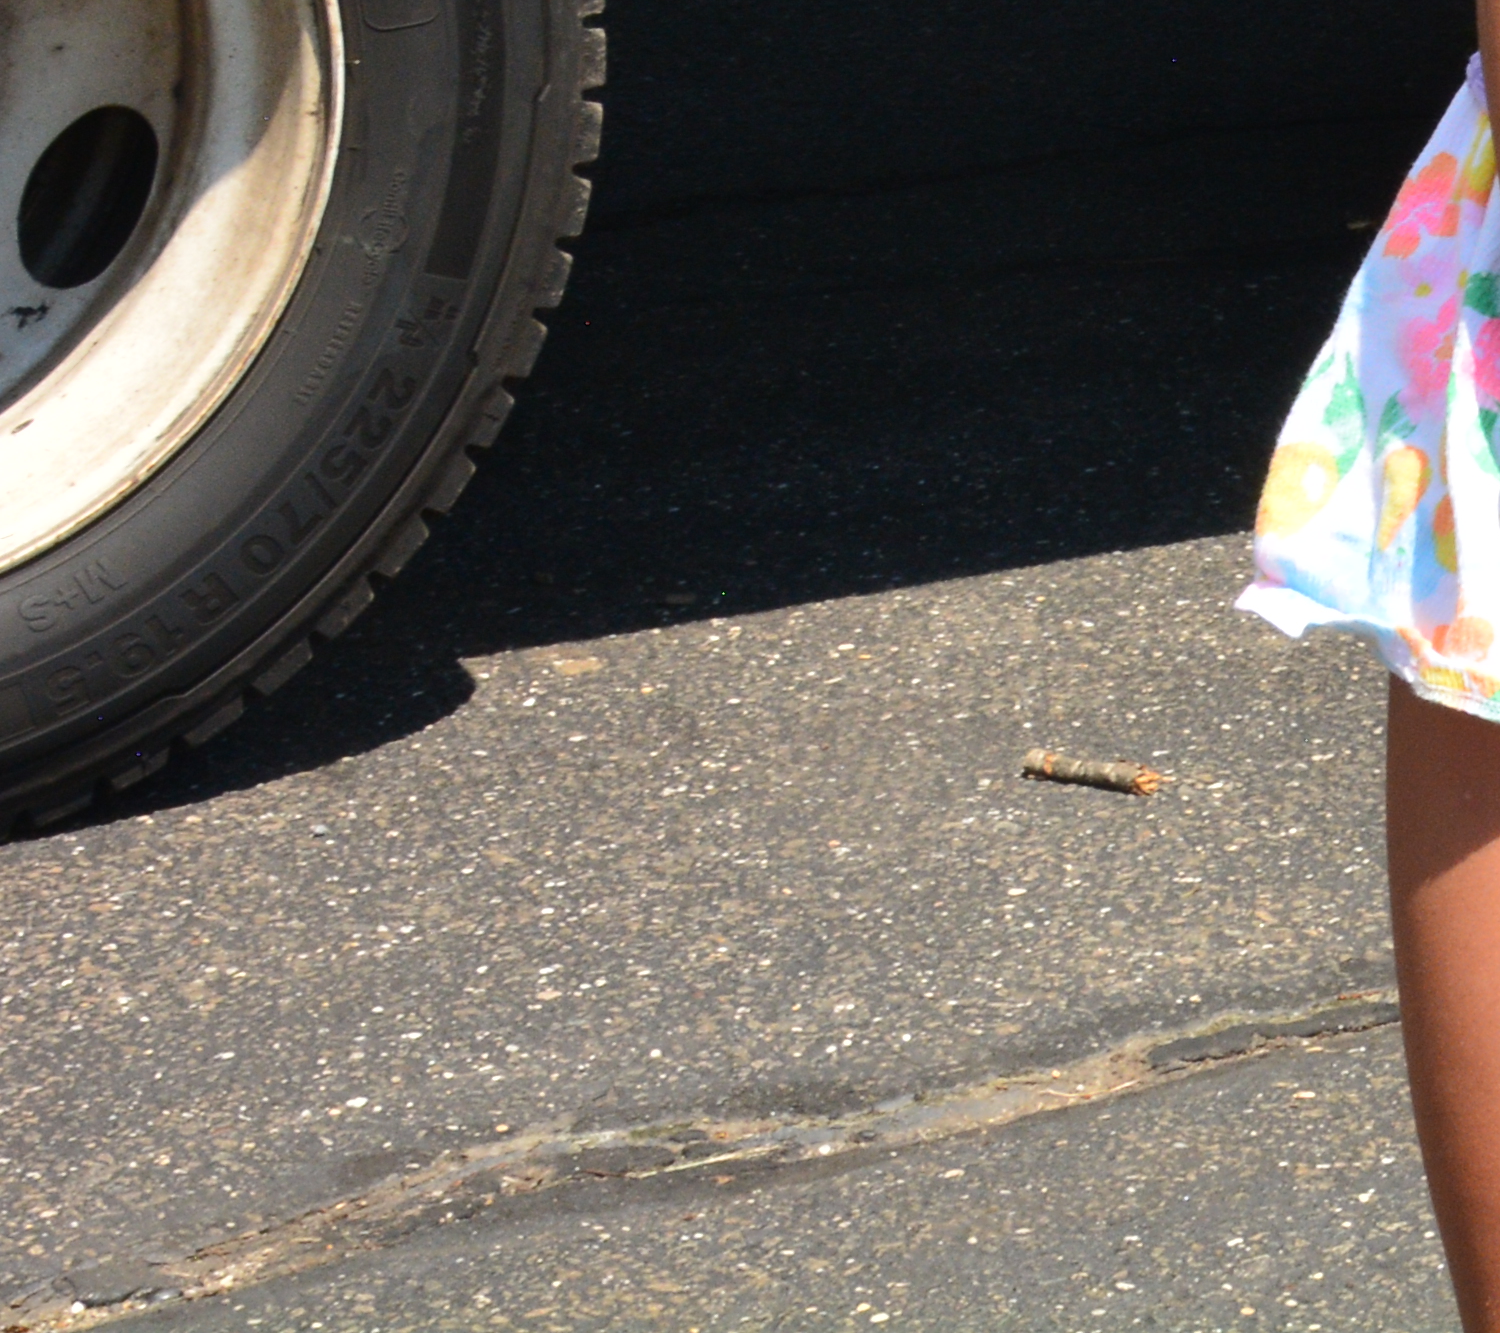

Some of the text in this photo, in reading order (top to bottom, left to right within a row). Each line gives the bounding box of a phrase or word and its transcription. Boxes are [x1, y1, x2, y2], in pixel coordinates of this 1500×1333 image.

[16, 557, 131, 633] M+S
[46, 366, 417, 718] 225/70 R 19.5
